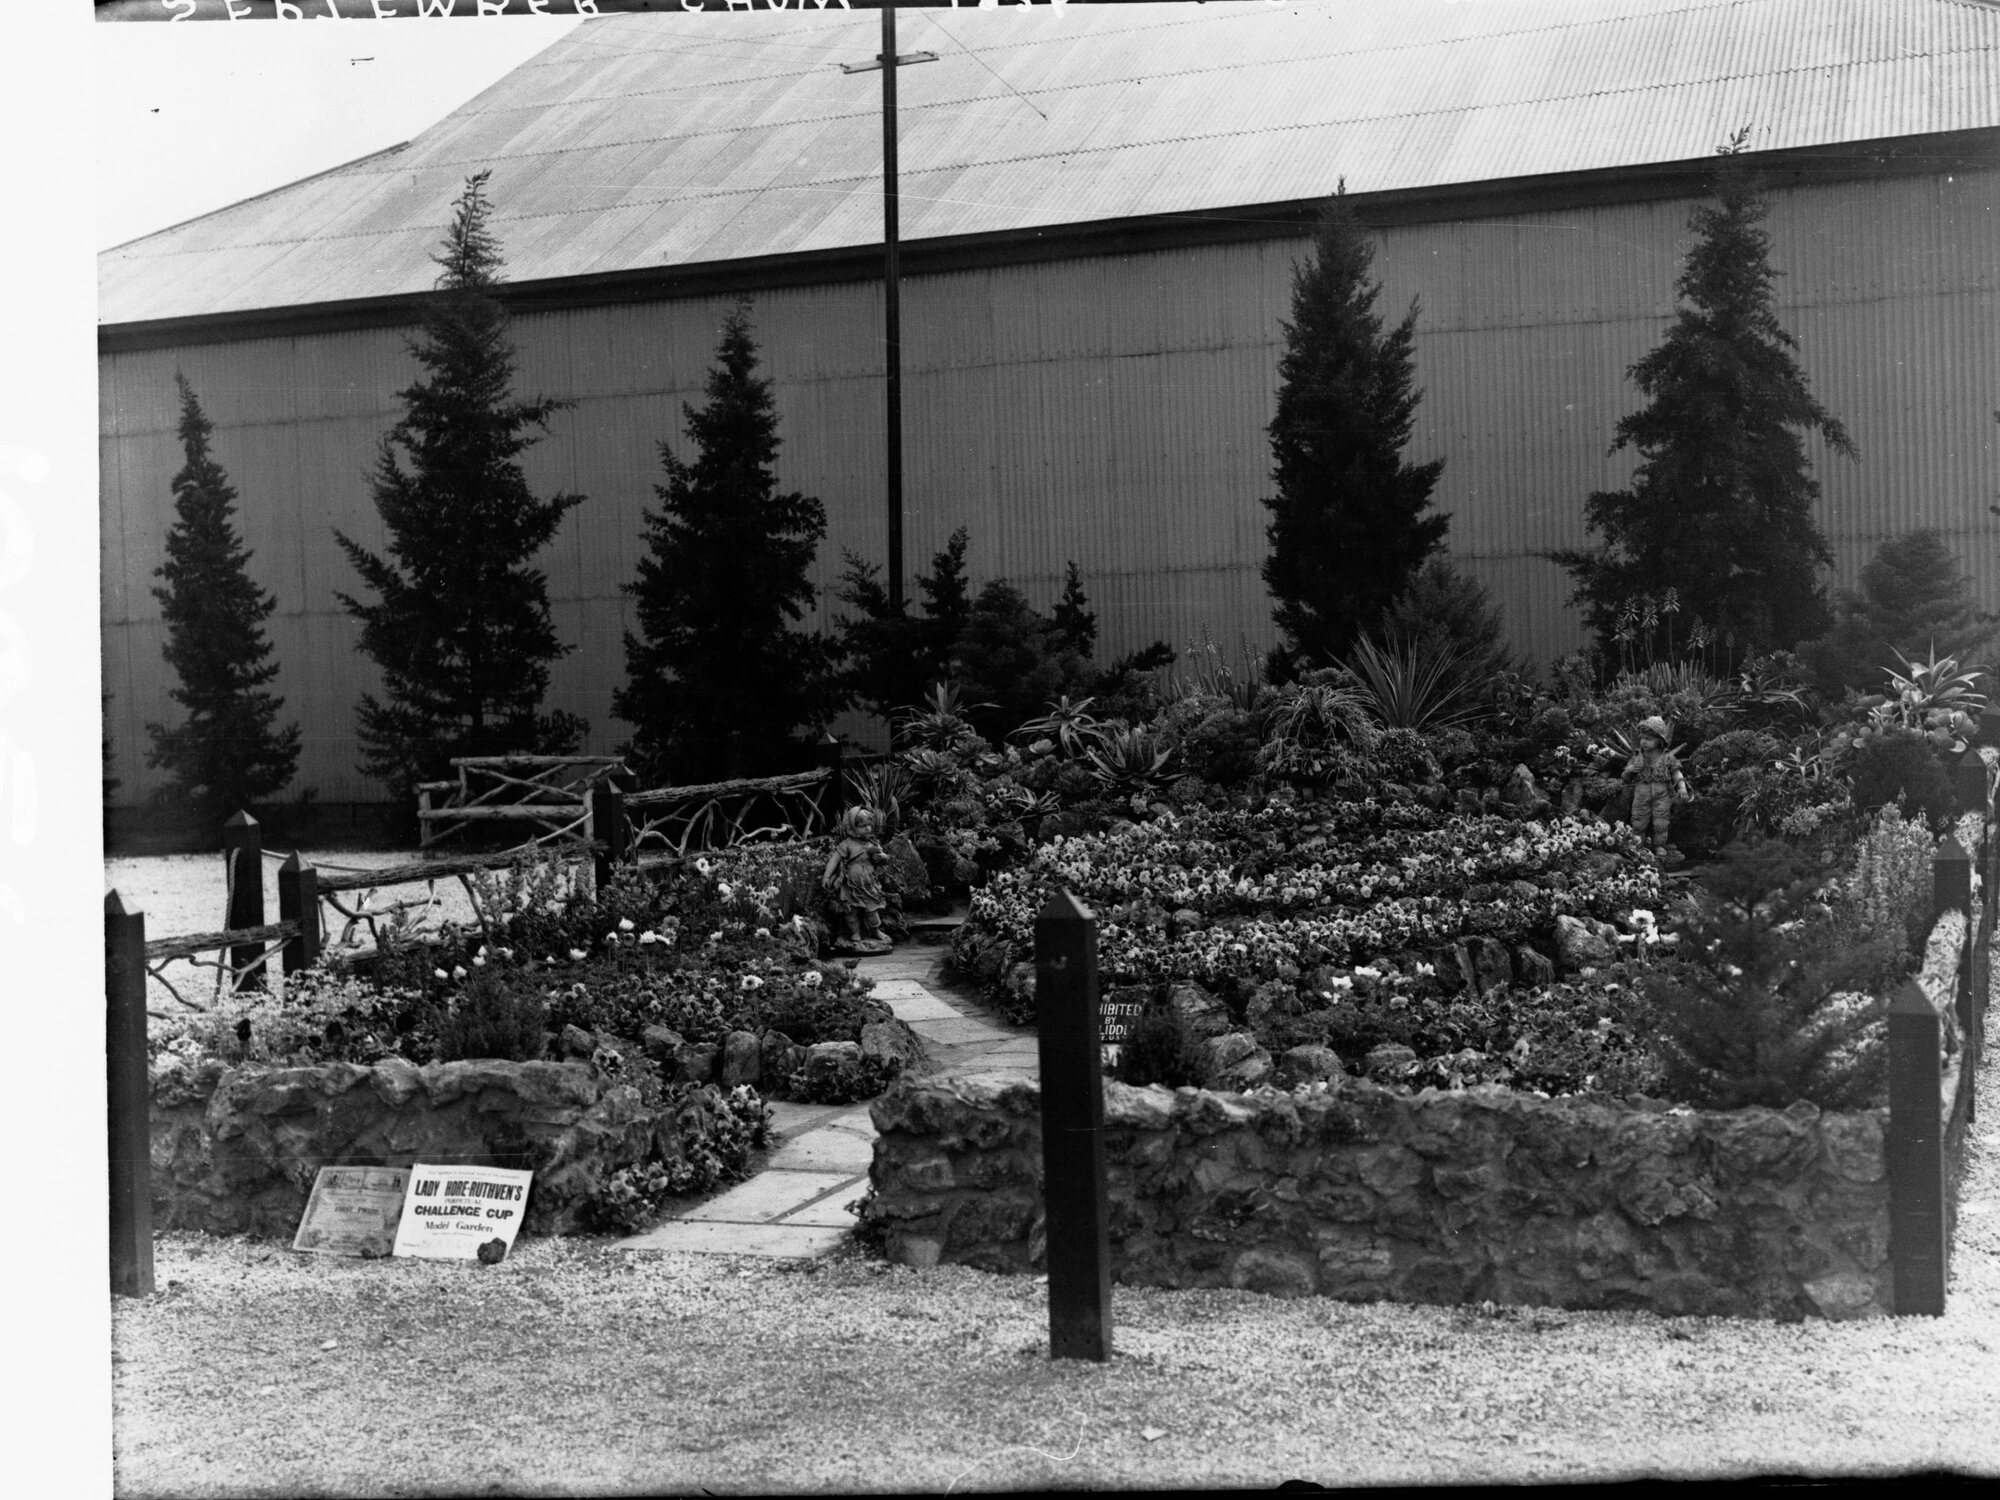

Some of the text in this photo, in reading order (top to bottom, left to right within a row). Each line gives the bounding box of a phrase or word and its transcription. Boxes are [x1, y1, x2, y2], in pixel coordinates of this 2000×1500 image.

[1104, 1016, 1116, 1025] BY
[414, 1179, 440, 1197] LADY
[444, 1180, 523, 1201] HORE-RUTHVEN'S
[414, 1205, 513, 1220] CHALLENGE CUP
[424, 1221, 493, 1233] Model Garden
